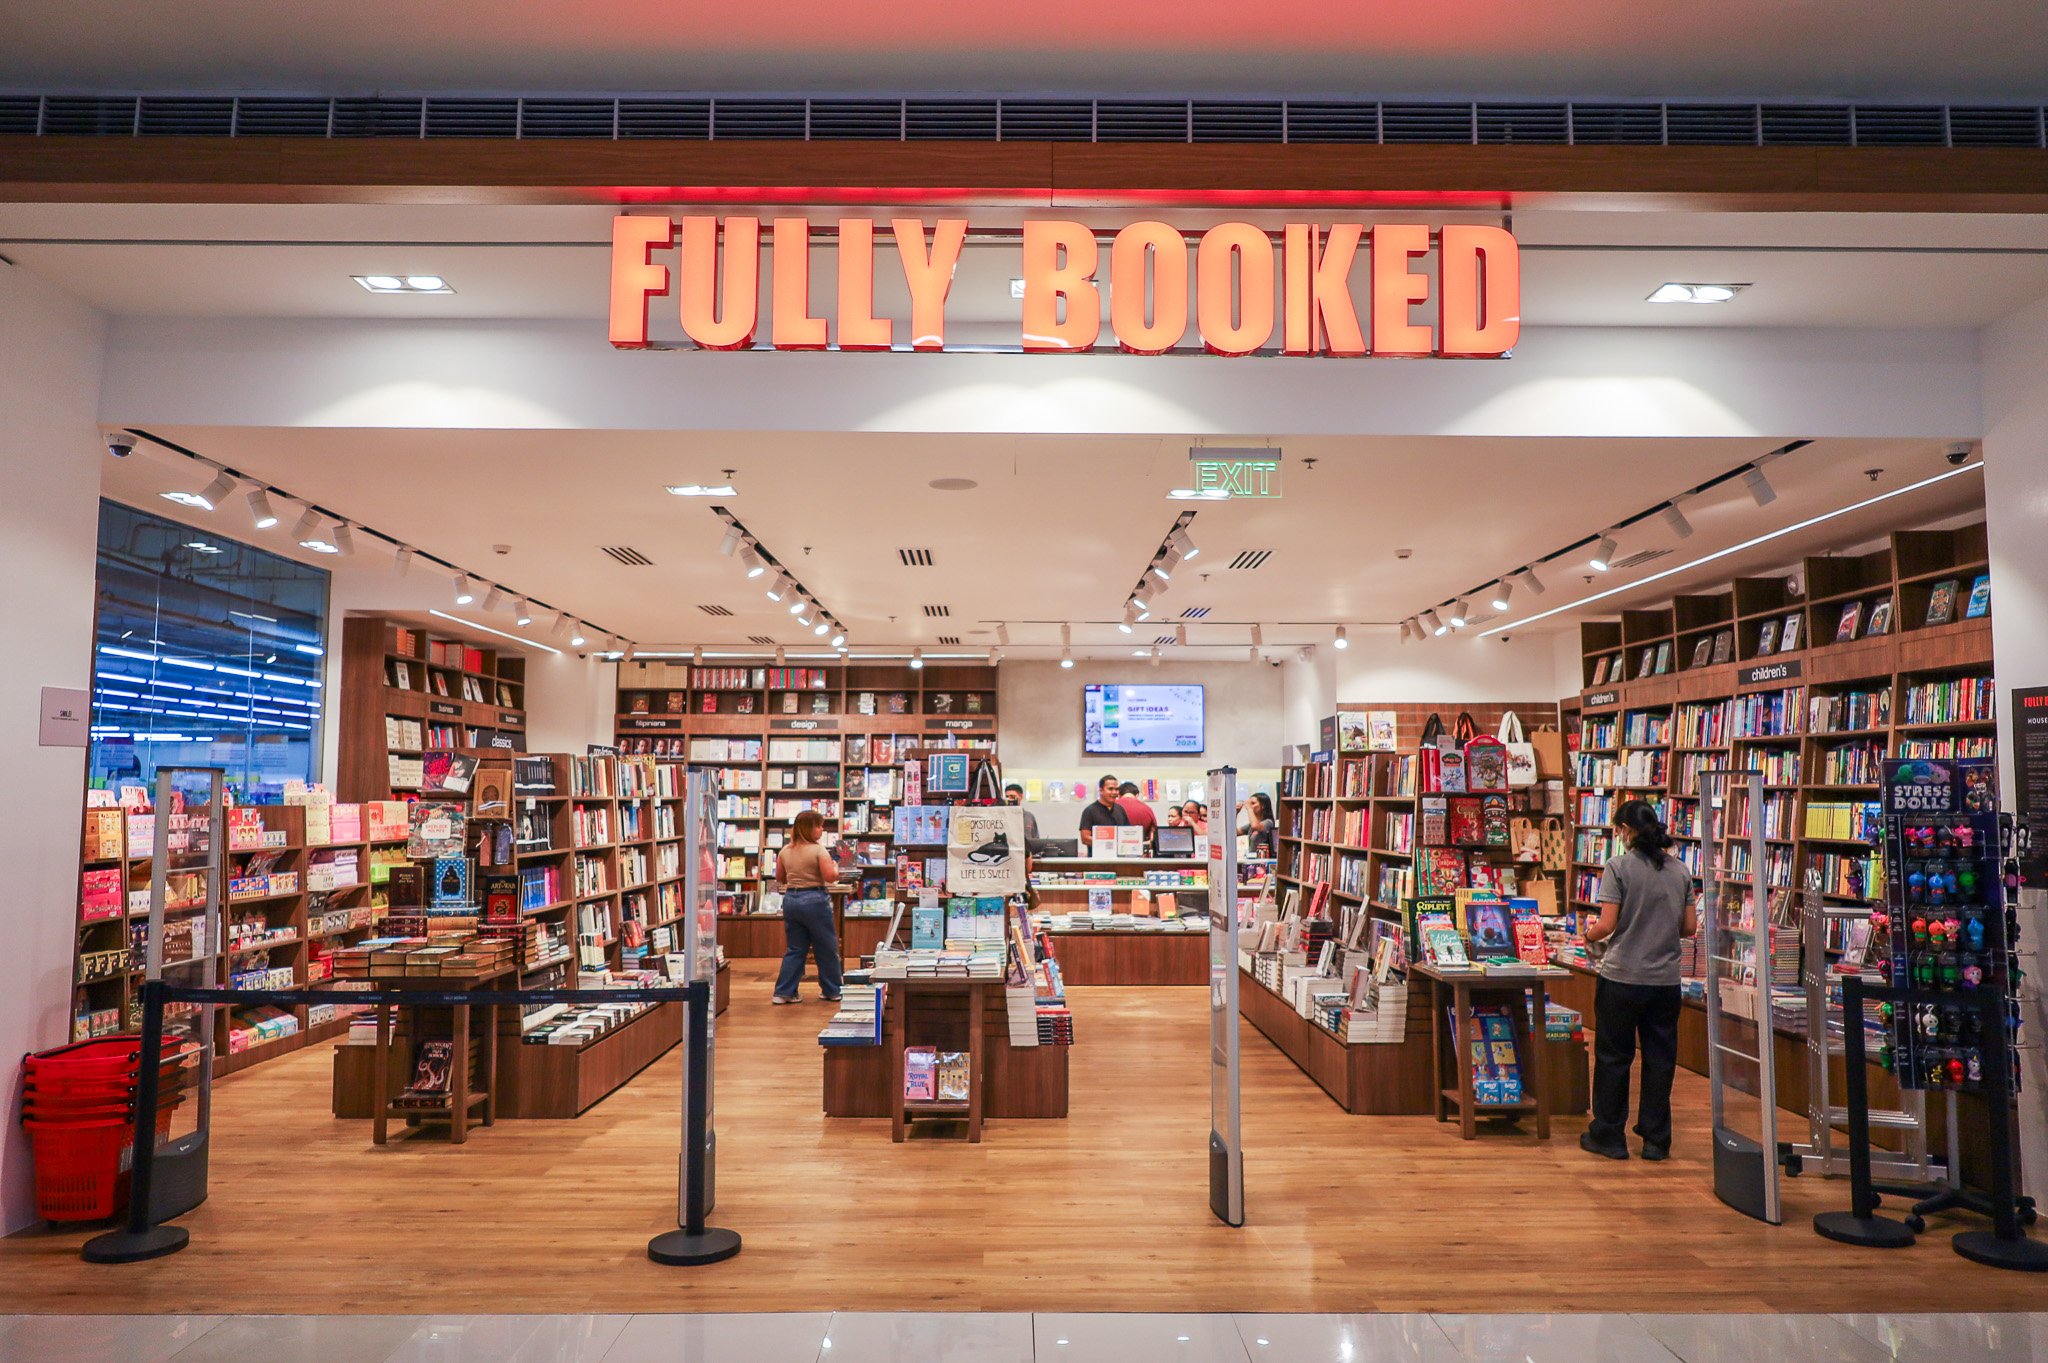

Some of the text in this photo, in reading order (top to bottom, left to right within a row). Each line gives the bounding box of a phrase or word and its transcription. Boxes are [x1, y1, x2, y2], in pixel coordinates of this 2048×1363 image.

[608, 215, 1521, 357] FULLY BOOKED
[1196, 462, 1277, 495] EXIT
[1751, 665, 1787, 681] children's
[1590, 693, 1614, 704] children's
[2024, 696, 2044, 707] FULLY
[791, 720, 817, 730] design
[945, 720, 973, 729] manga
[491, 735, 512, 748] classics
[1894, 785, 1952, 797] STRESS
[1894, 797, 1951, 809] DOLLS
[970, 820, 1004, 830] OKSTORES
[961, 869, 1010, 879] LIFE IS SWEET
[908, 1072, 929, 1080] ROYAL
[908, 1080, 925, 1088] BLUE
